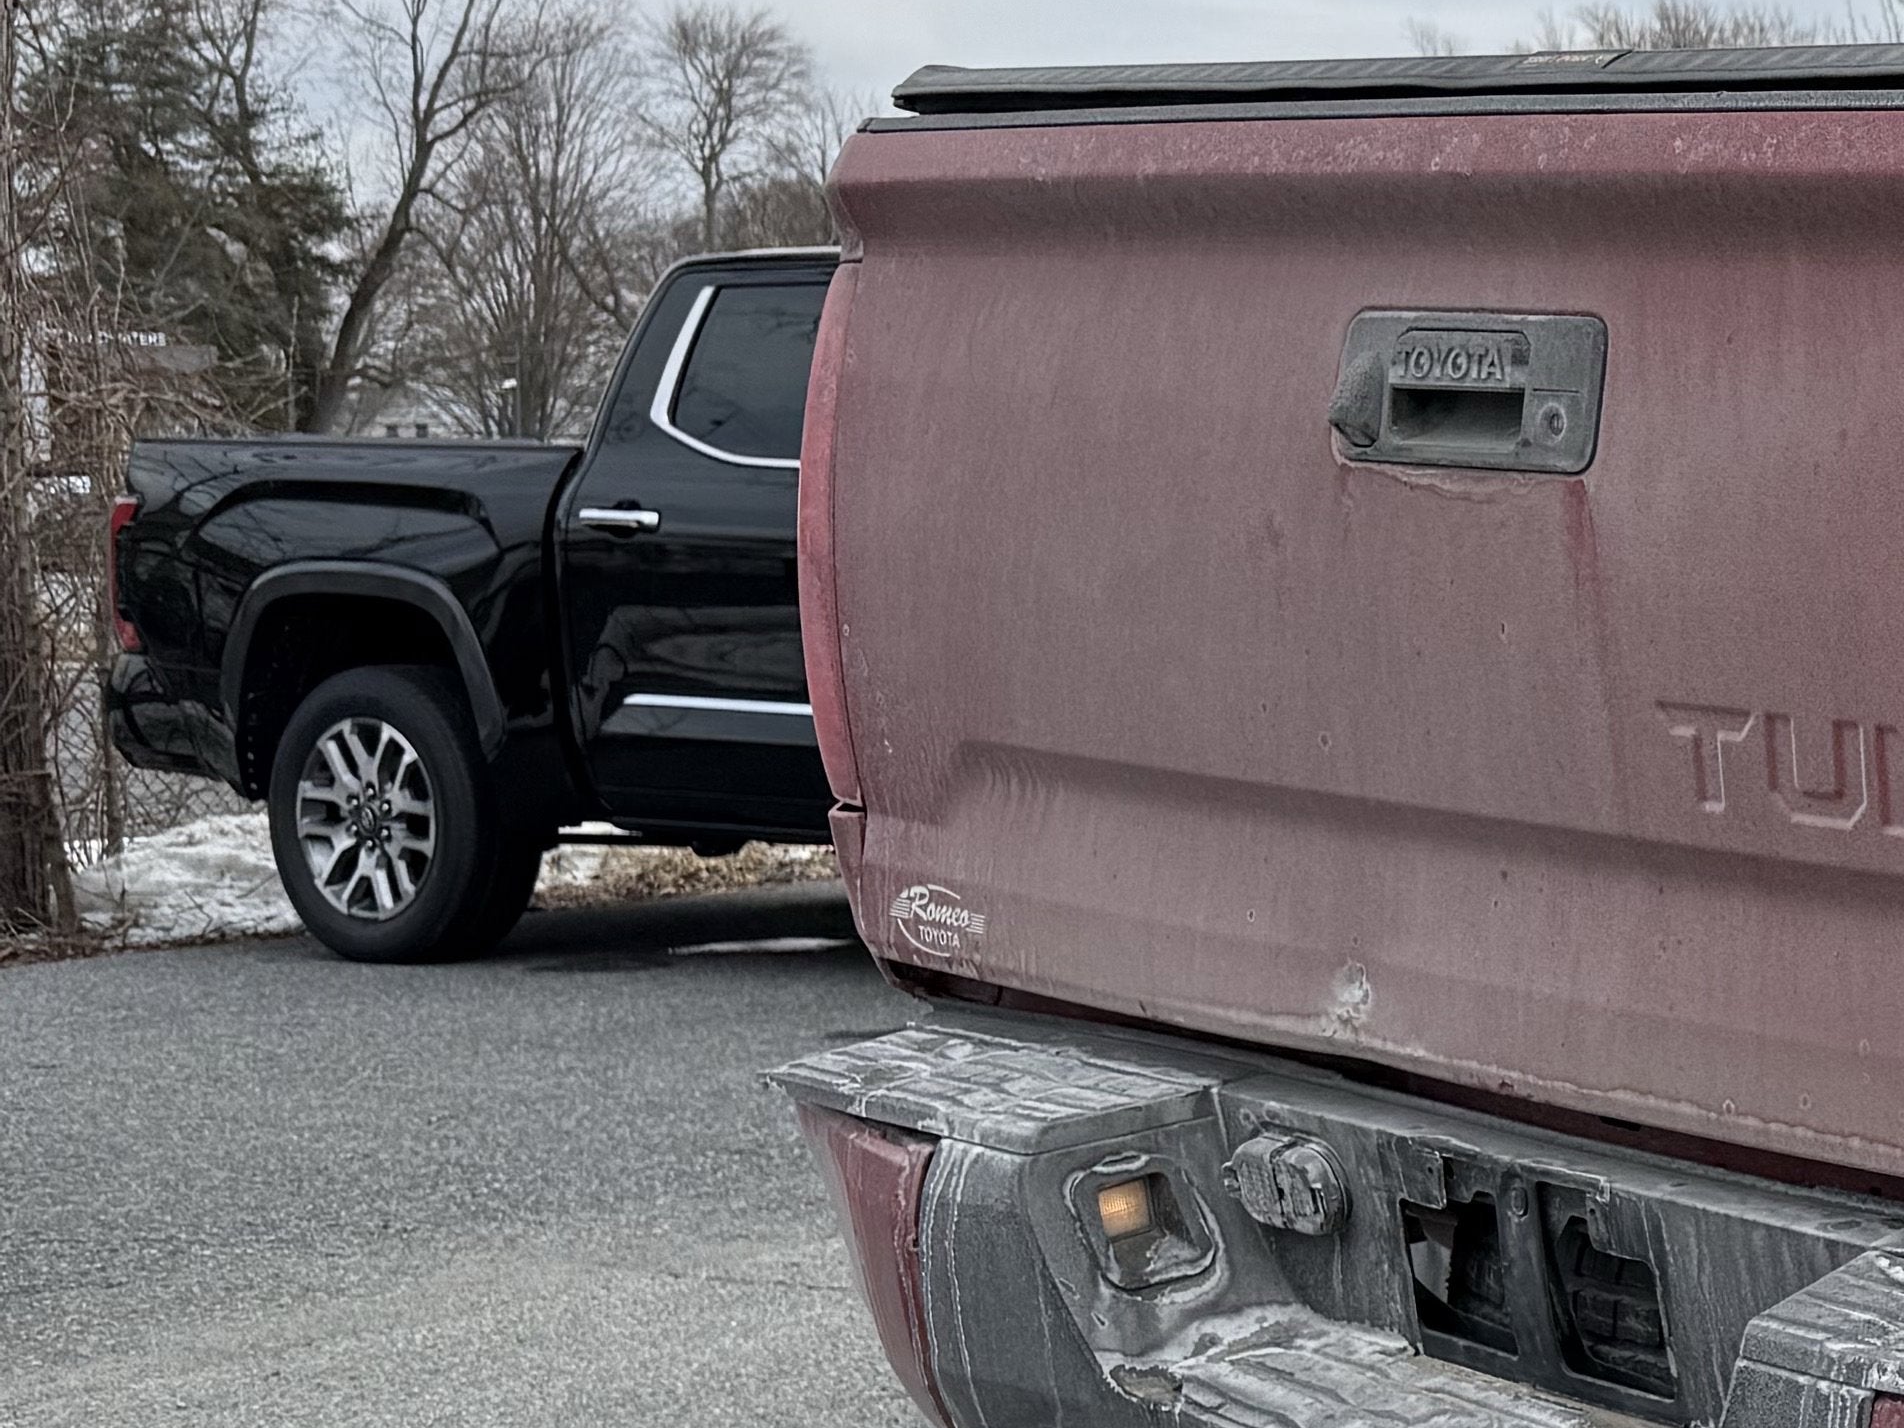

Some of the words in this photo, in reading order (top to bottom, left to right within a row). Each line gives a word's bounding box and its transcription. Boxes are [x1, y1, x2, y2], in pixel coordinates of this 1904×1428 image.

[1397, 346, 1505, 381] TOYOTA
[909, 885, 970, 928] Romeo
[918, 925, 961, 949] TOYOTA
